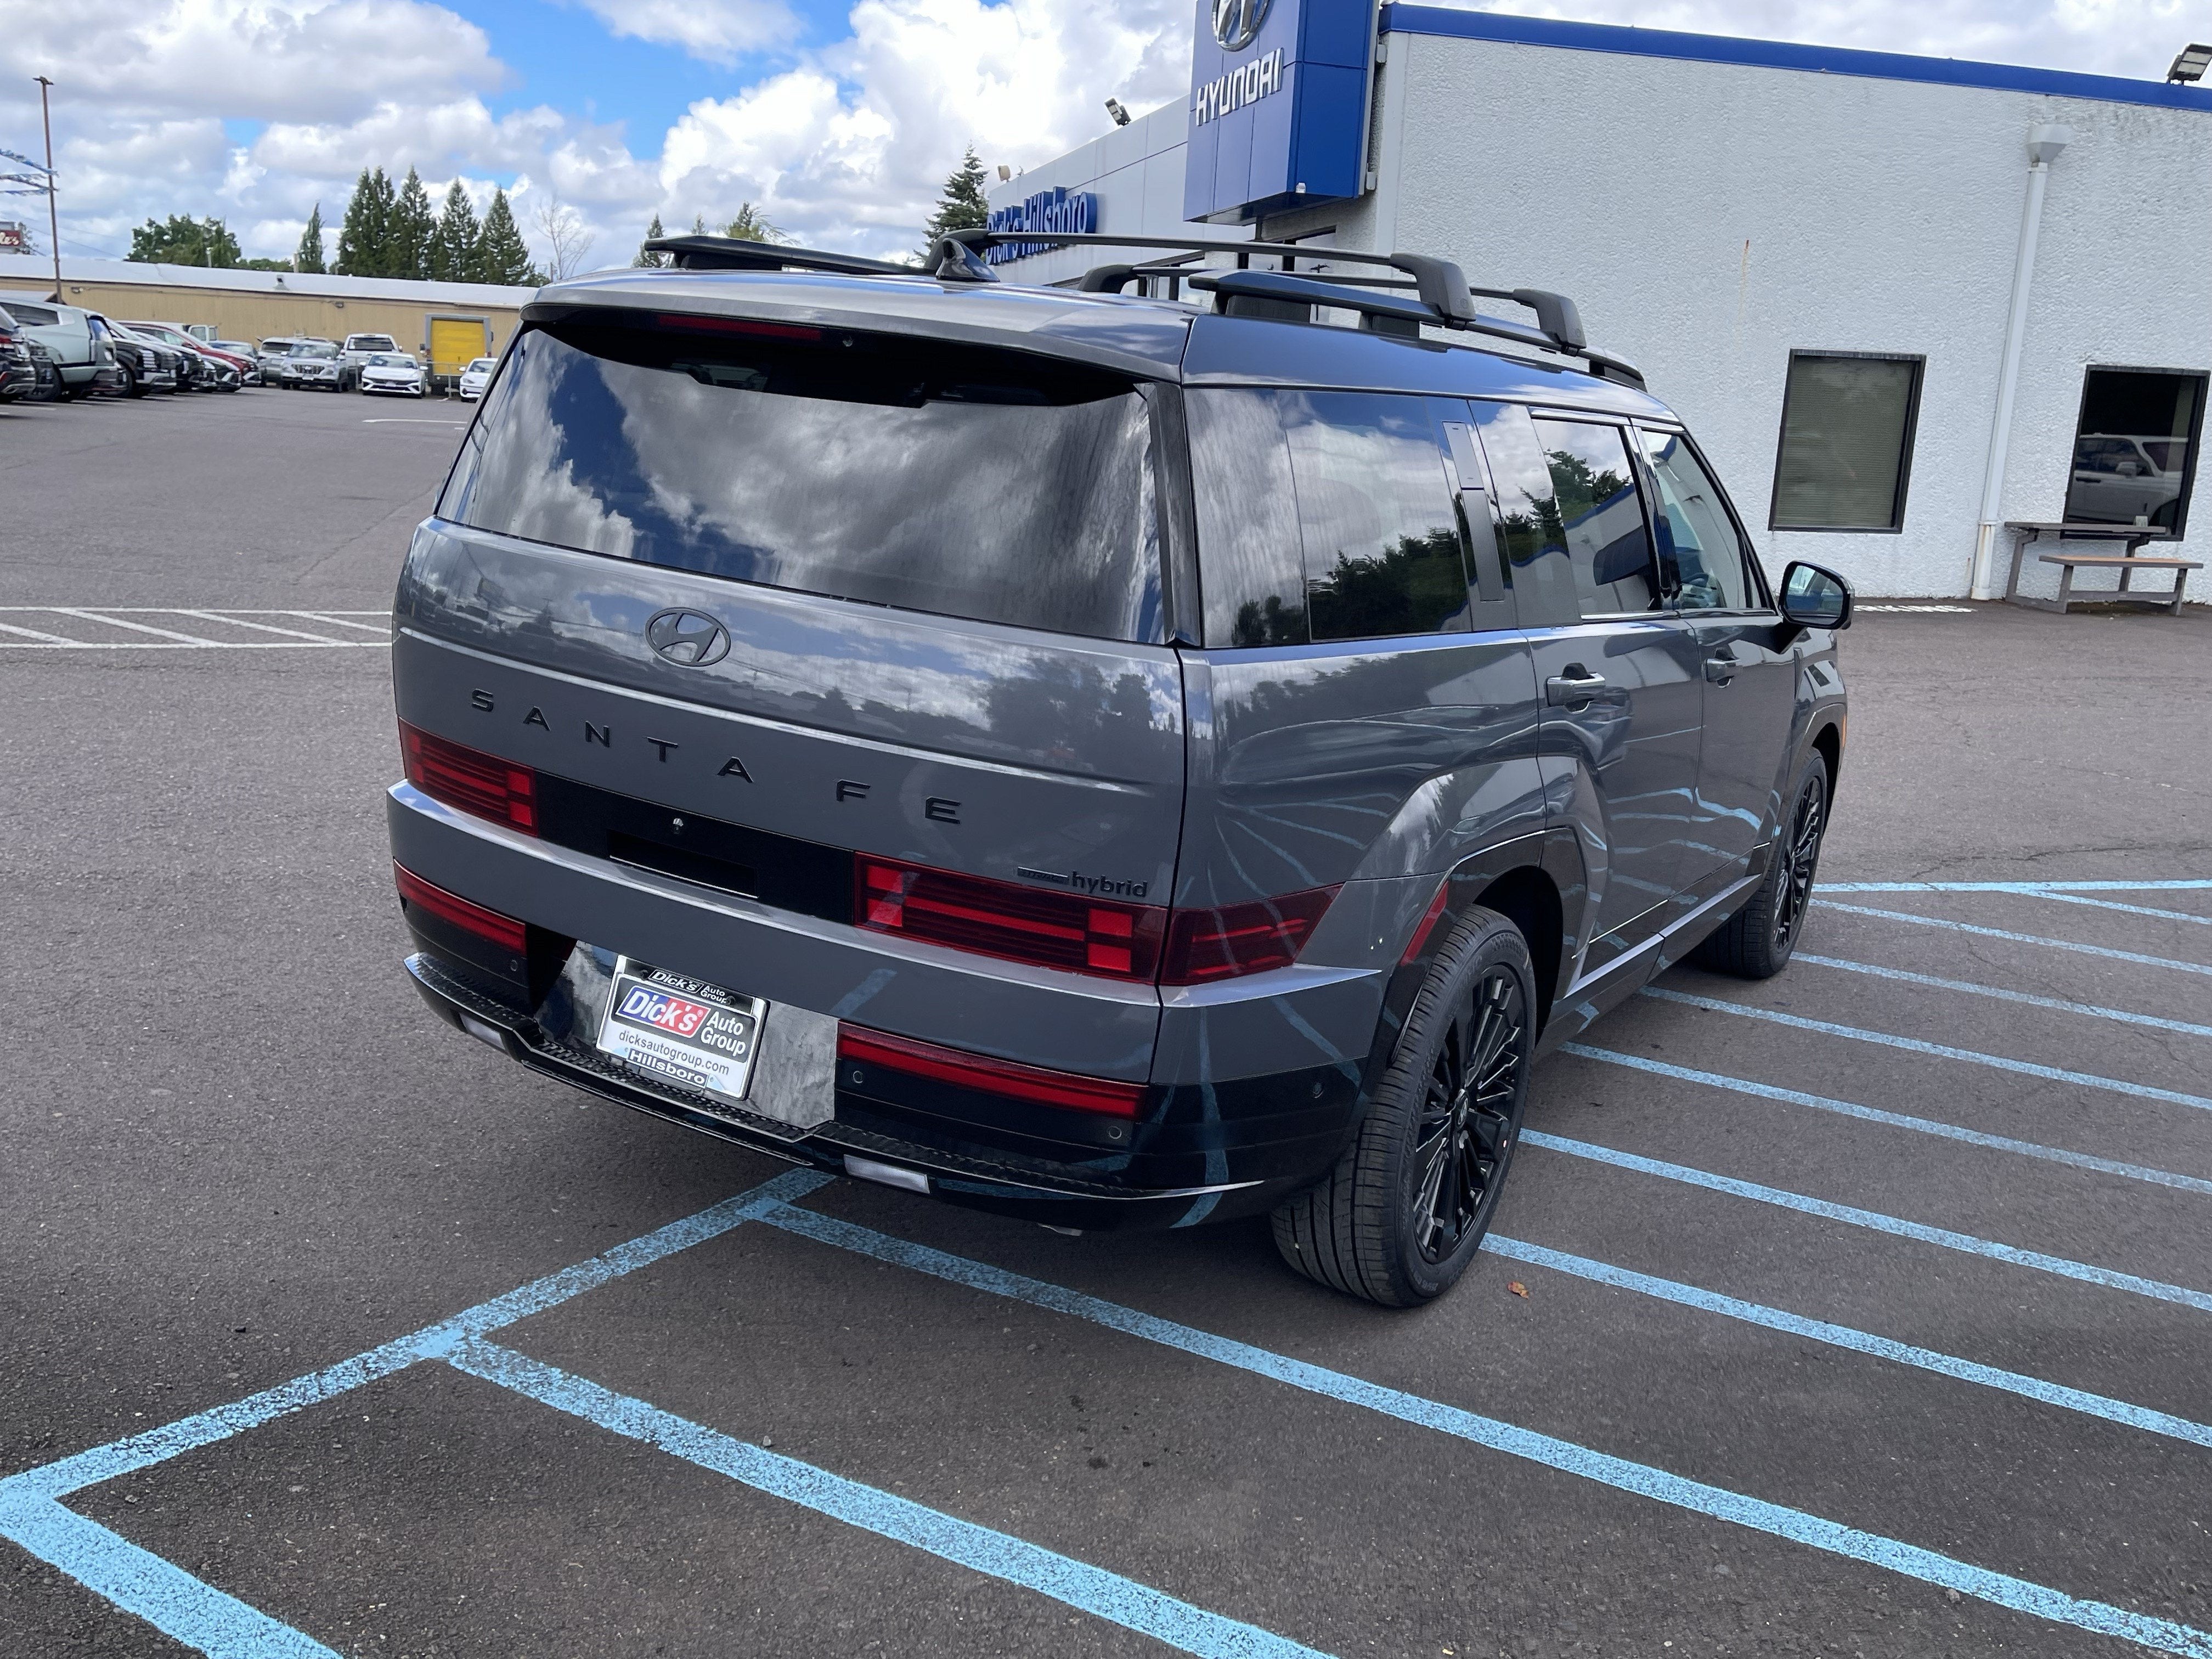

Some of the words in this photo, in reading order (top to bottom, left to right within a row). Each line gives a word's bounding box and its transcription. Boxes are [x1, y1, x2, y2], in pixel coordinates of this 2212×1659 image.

[1196, 48, 1283, 127] HYUNDAI
[1023, 186, 1091, 256] Hillsboro
[471, 689, 754, 783] SANTA
[836, 779, 961, 825] FE
[1072, 870, 1148, 898] hybrid
[652, 971, 698, 991] Dick's
[702, 985, 725, 996] Auto
[707, 1012, 743, 1036] Auto
[619, 1030, 730, 1076] dicksautogroup.com
[701, 1028, 746, 1057] Group
[629, 1050, 706, 1085] Hillsboro
